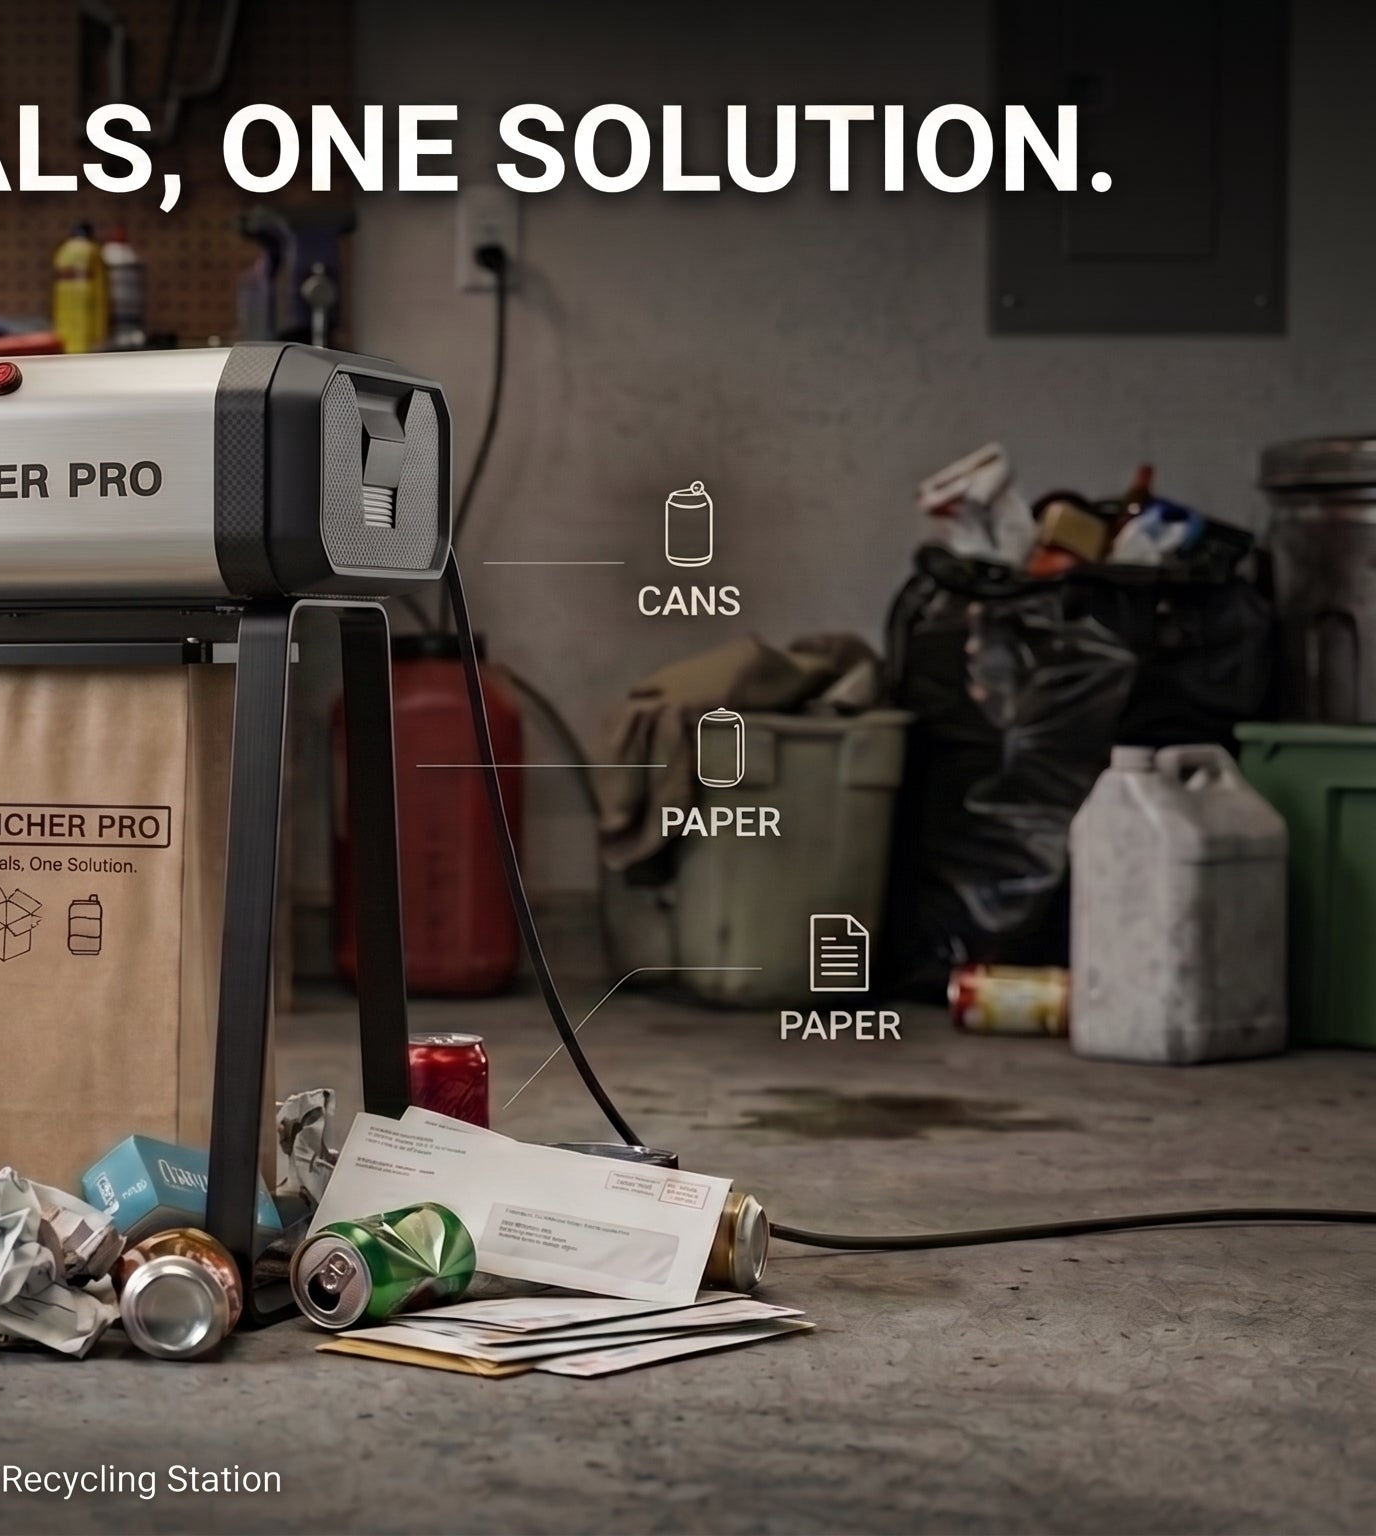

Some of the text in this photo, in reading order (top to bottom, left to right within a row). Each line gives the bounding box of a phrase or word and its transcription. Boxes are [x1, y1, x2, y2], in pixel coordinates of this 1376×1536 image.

[68, 459, 164, 499] PRO
[97, 814, 162, 840] PRO
[29, 856, 63, 873] One
[67, 857, 138, 875] Solution.
